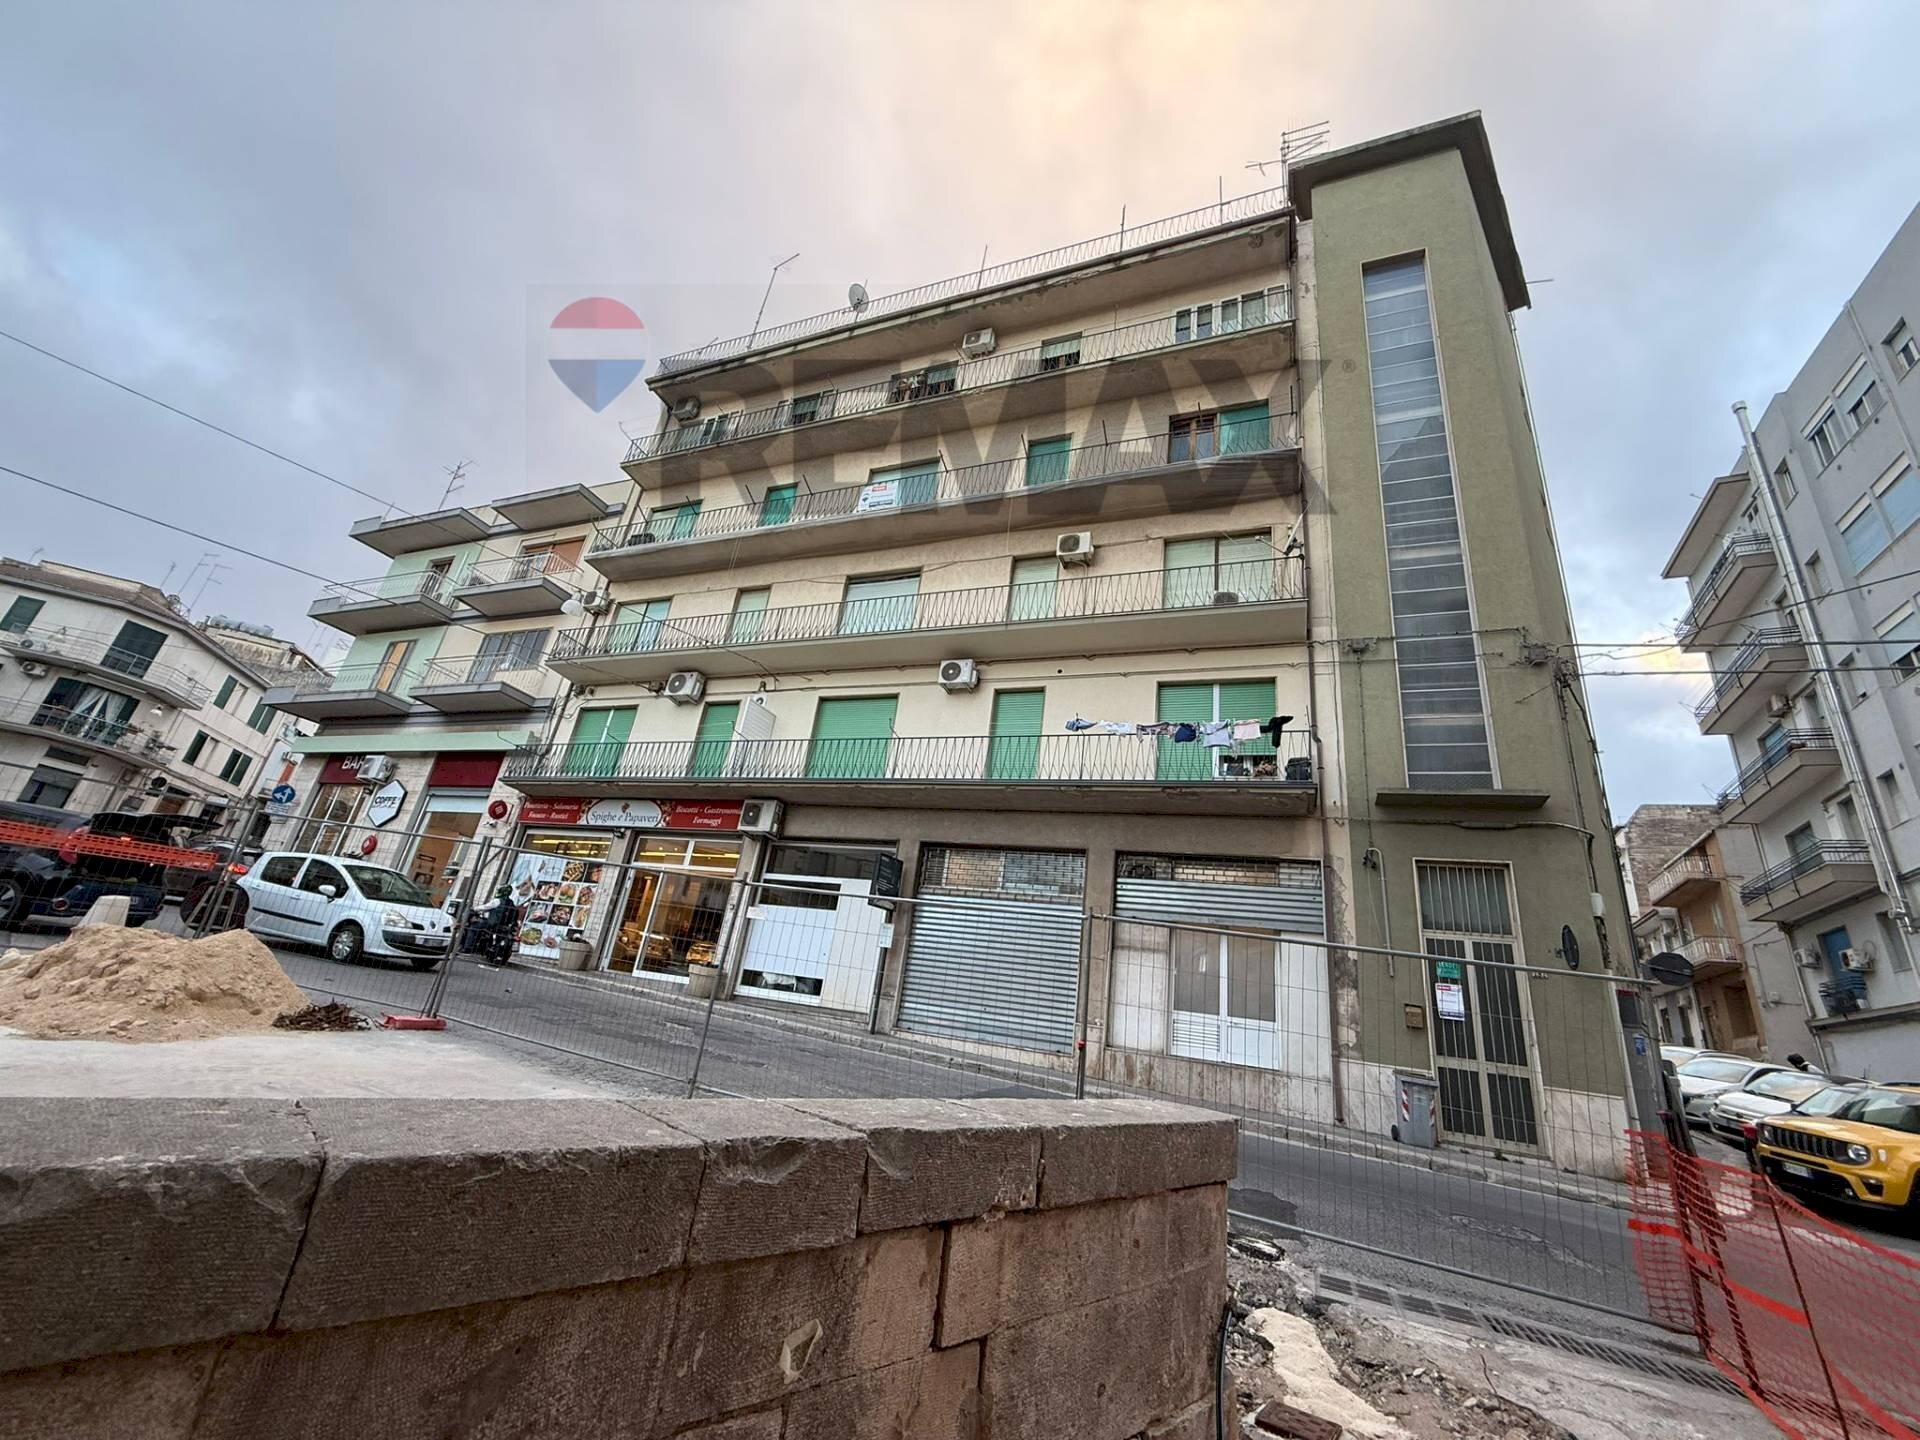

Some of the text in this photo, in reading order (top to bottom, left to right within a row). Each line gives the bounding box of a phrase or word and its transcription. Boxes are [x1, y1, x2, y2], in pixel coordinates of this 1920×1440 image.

[675, 805, 699, 814] Biscotti
[591, 810, 617, 824] Spighe
[624, 811, 659, 825] Papaveri
[692, 816, 722, 827] Formaggi
